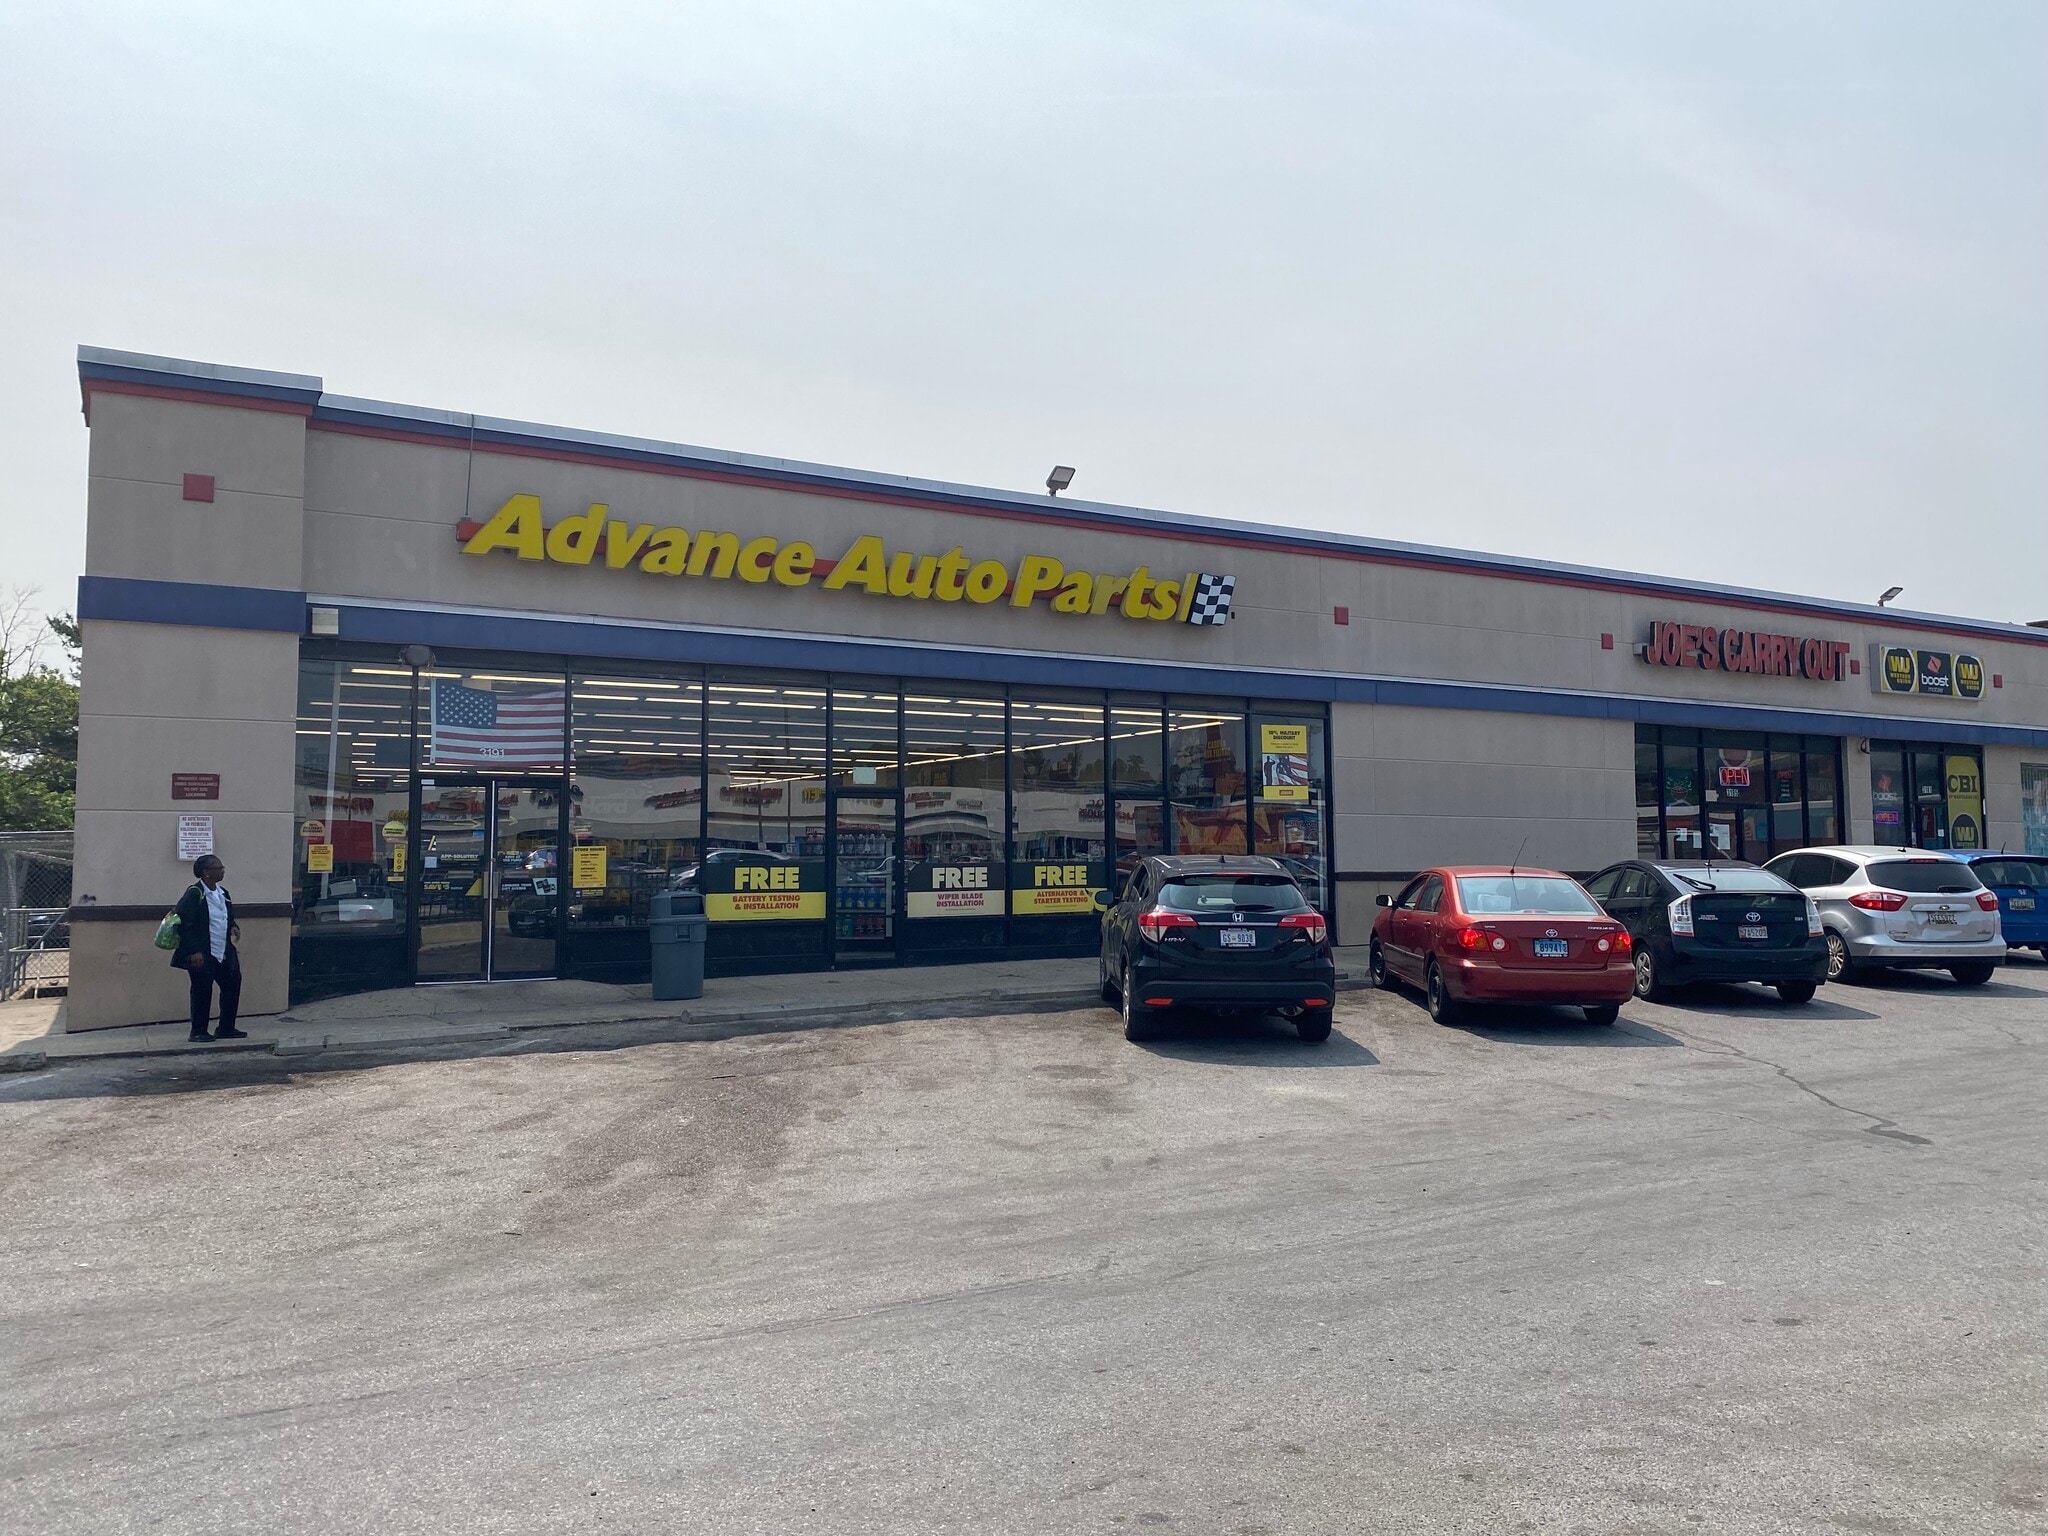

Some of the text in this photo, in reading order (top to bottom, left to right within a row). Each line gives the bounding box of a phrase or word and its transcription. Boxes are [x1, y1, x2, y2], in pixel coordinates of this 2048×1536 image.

[460, 493, 1181, 621] Advance Auto Parts
[1643, 621, 1850, 681] JOE'S CARRY OUT
[1921, 674, 1949, 687] boost
[480, 748, 505, 758] 3191
[1721, 768, 1748, 784] OPEN
[1947, 775, 1978, 793] CBI
[1873, 791, 1897, 801] boost
[1877, 813, 1895, 821] OPEN
[735, 867, 800, 890] FREE
[932, 866, 988, 889] FREE
[1034, 865, 1088, 887] FREE
[1222, 933, 1231, 943] GS
